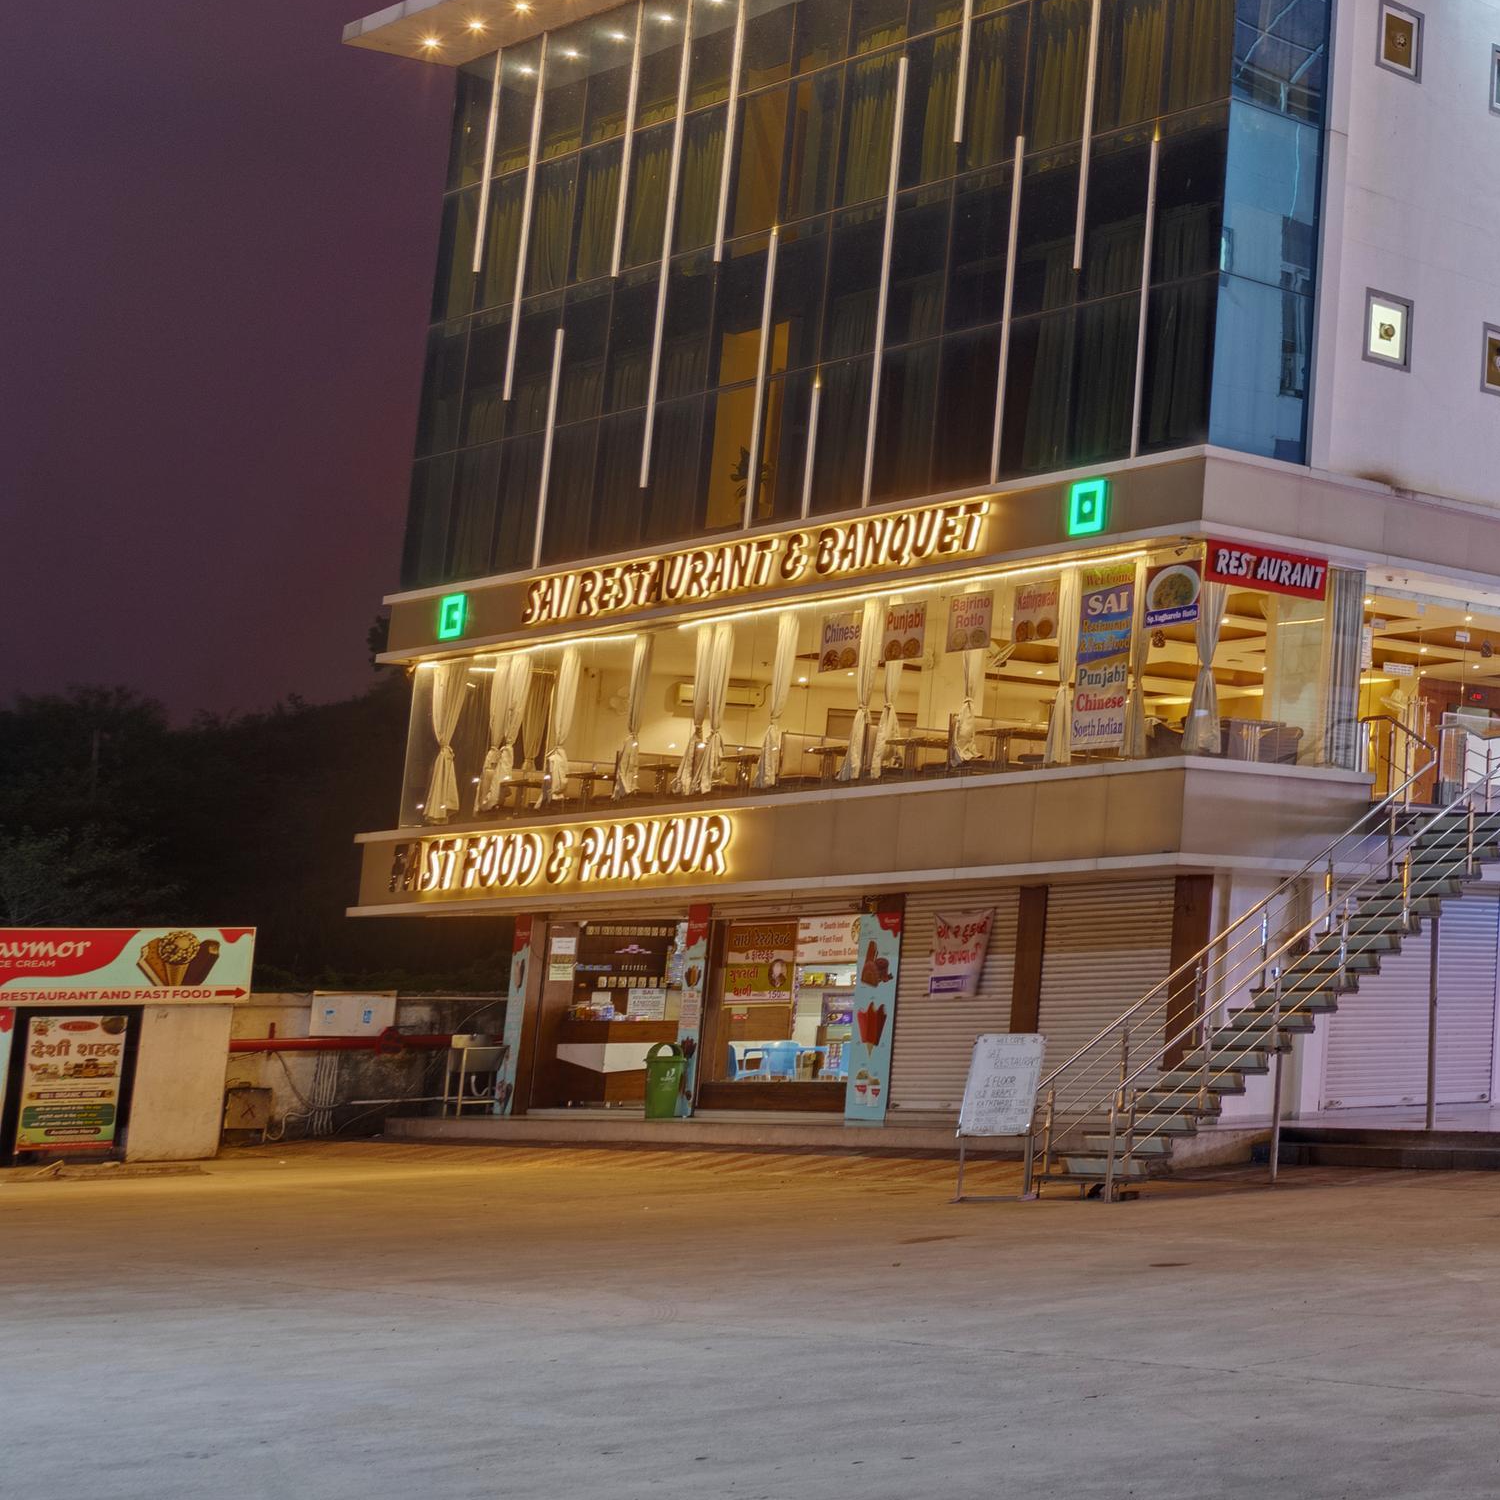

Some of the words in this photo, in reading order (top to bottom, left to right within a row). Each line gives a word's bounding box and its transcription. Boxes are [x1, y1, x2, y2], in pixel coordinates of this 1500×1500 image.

[522, 578, 574, 625] SAI
[579, 539, 778, 613] RESTAURANT
[780, 534, 812, 580] &
[816, 501, 990, 575] BANQUET
[1215, 548, 1326, 591] RESTAURANT
[952, 596, 991, 614] Bajrino
[1088, 591, 1129, 615] SAI
[887, 608, 923, 634] Punjabi
[956, 614, 984, 628] Rotlo
[825, 623, 860, 644] Chinese
[1078, 665, 1126, 688] Punjabi
[1076, 694, 1124, 712] Chinese
[1073, 719, 1096, 739] South
[1097, 718, 1123, 736] Indian
[389, 836, 461, 892] FAST
[462, 832, 542, 888] FOOD
[546, 830, 572, 884] &
[578, 815, 732, 882] PARLOUR
[1, 991, 97, 1002] RESTAURANT
[100, 990, 131, 1000] AND
[135, 990, 169, 1000] FAST
[172, 989, 212, 999] FOOD
[31, 1039, 71, 1058] देशी
